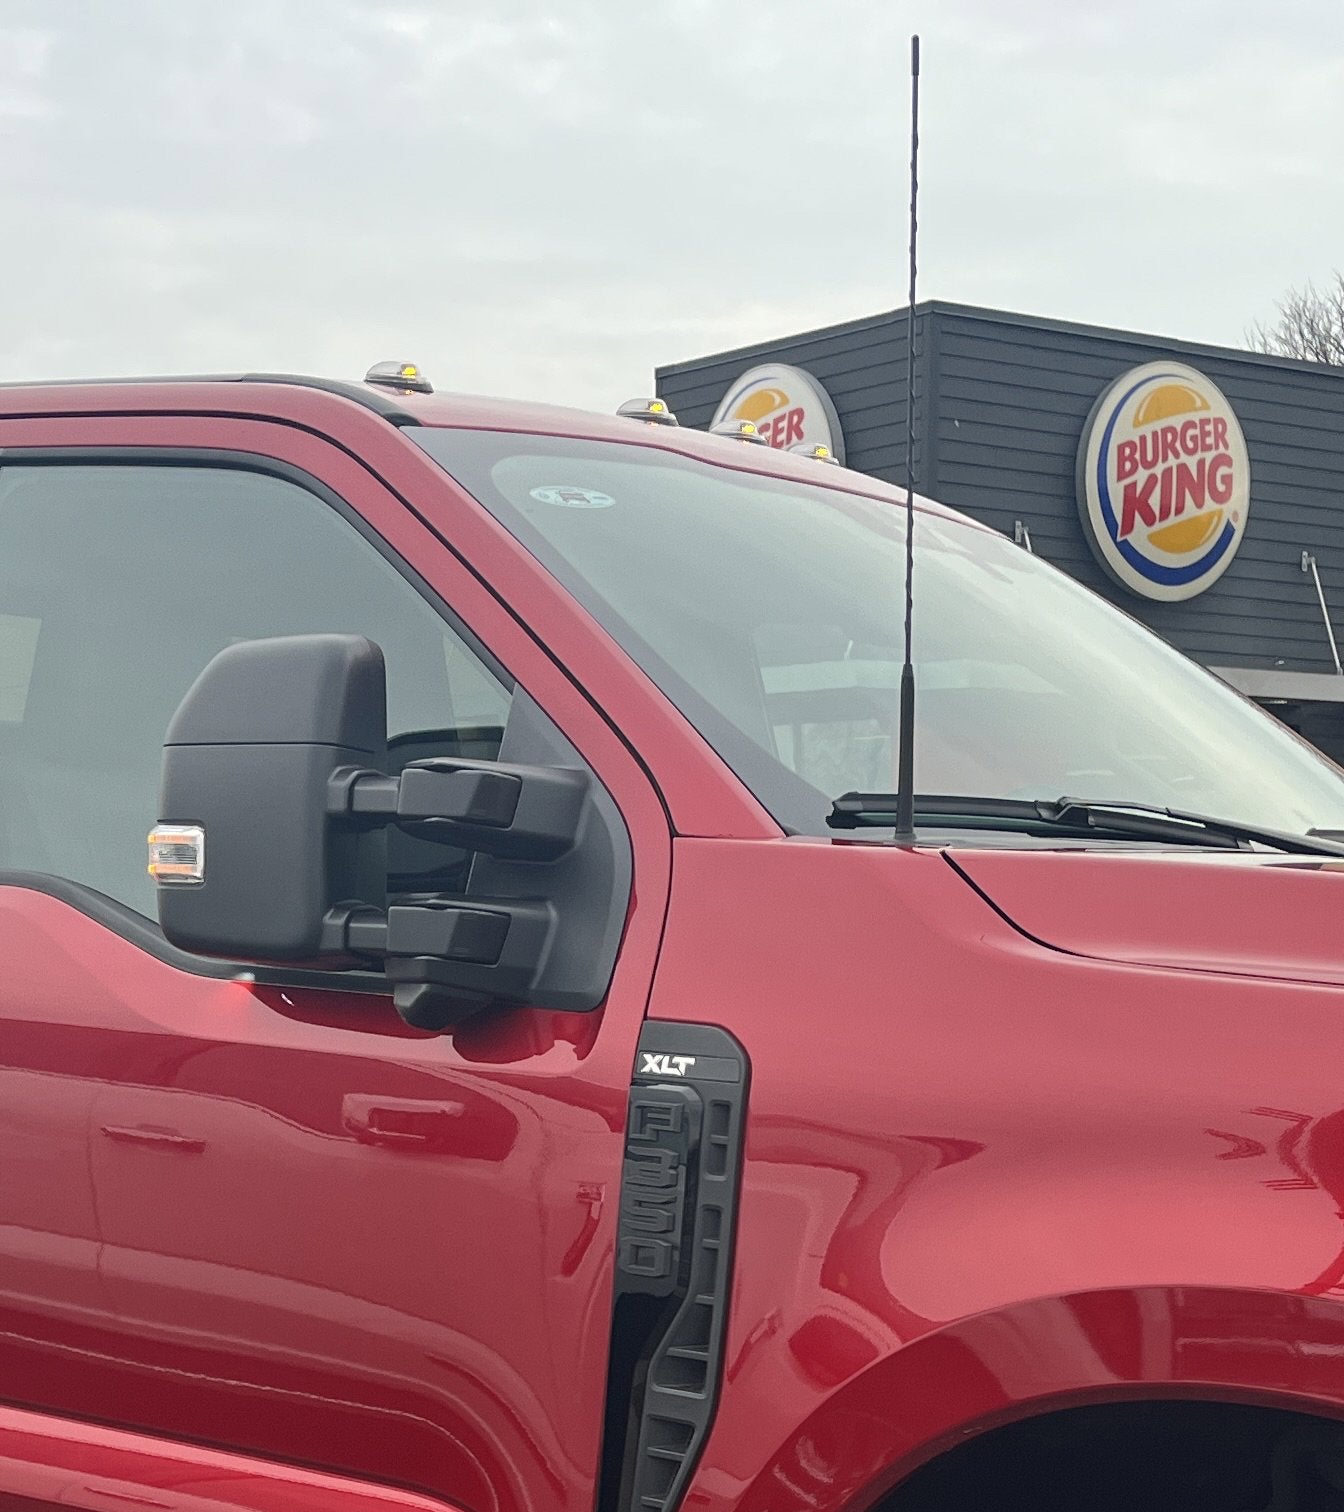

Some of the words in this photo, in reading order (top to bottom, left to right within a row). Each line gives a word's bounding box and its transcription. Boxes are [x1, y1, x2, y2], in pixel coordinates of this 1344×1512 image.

[758, 407, 805, 449] GER
[1117, 417, 1229, 482] BURGER
[1119, 453, 1233, 538] KING
[640, 1053, 696, 1077] XLT
